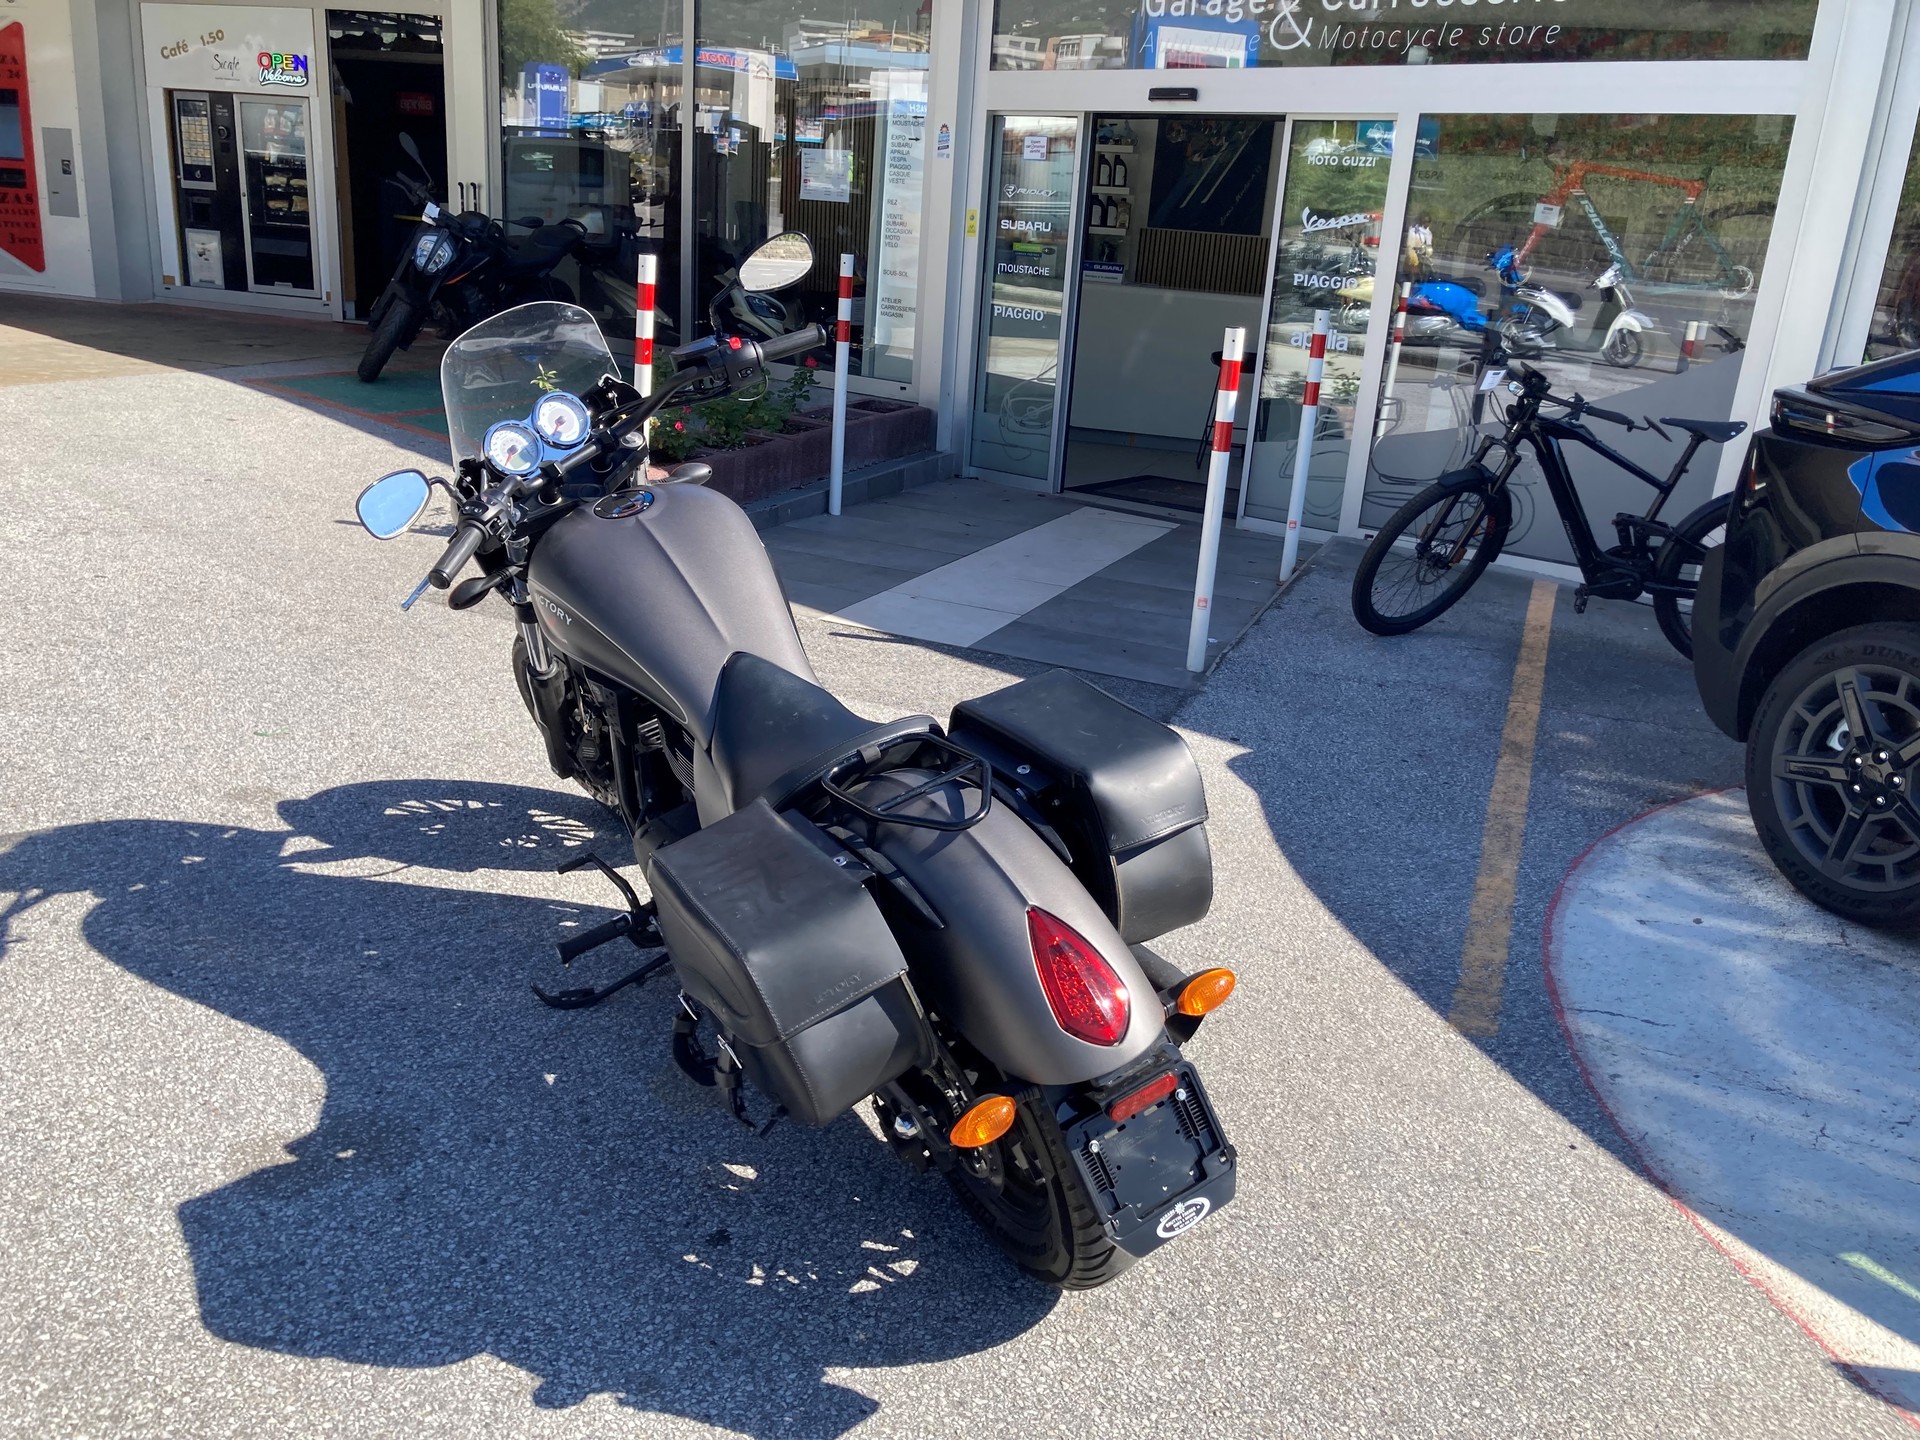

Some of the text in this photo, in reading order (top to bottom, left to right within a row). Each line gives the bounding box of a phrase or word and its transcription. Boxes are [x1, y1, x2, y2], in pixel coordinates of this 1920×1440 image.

[160, 29, 225, 60] Café 1.50
[1318, 21, 1464, 55] Motocycle
[1478, 22, 1562, 46] store
[257, 52, 308, 72] OPEN
[259, 67, 308, 87] Welcome
[892, 120, 925, 128] MOUSTACHE
[1308, 155, 1376, 167] MOTO GUZZI
[1016, 187, 1056, 198] RIDLEY
[1000, 219, 1052, 232] SUBARU
[1301, 206, 1370, 233] Vespa
[885, 227, 912, 235] OCCASION
[1580, 199, 1624, 259] RIDLEY
[882, 269, 908, 278] SOUS-SOL
[997, 262, 1050, 276] MOUSTACHE
[1293, 273, 1359, 289] PIAGGIO
[880, 303, 916, 313] CARROSSERIE
[880, 310, 903, 318] MAGASIN
[994, 305, 1045, 321] PIAGGIO
[1290, 329, 1349, 351] aplia
